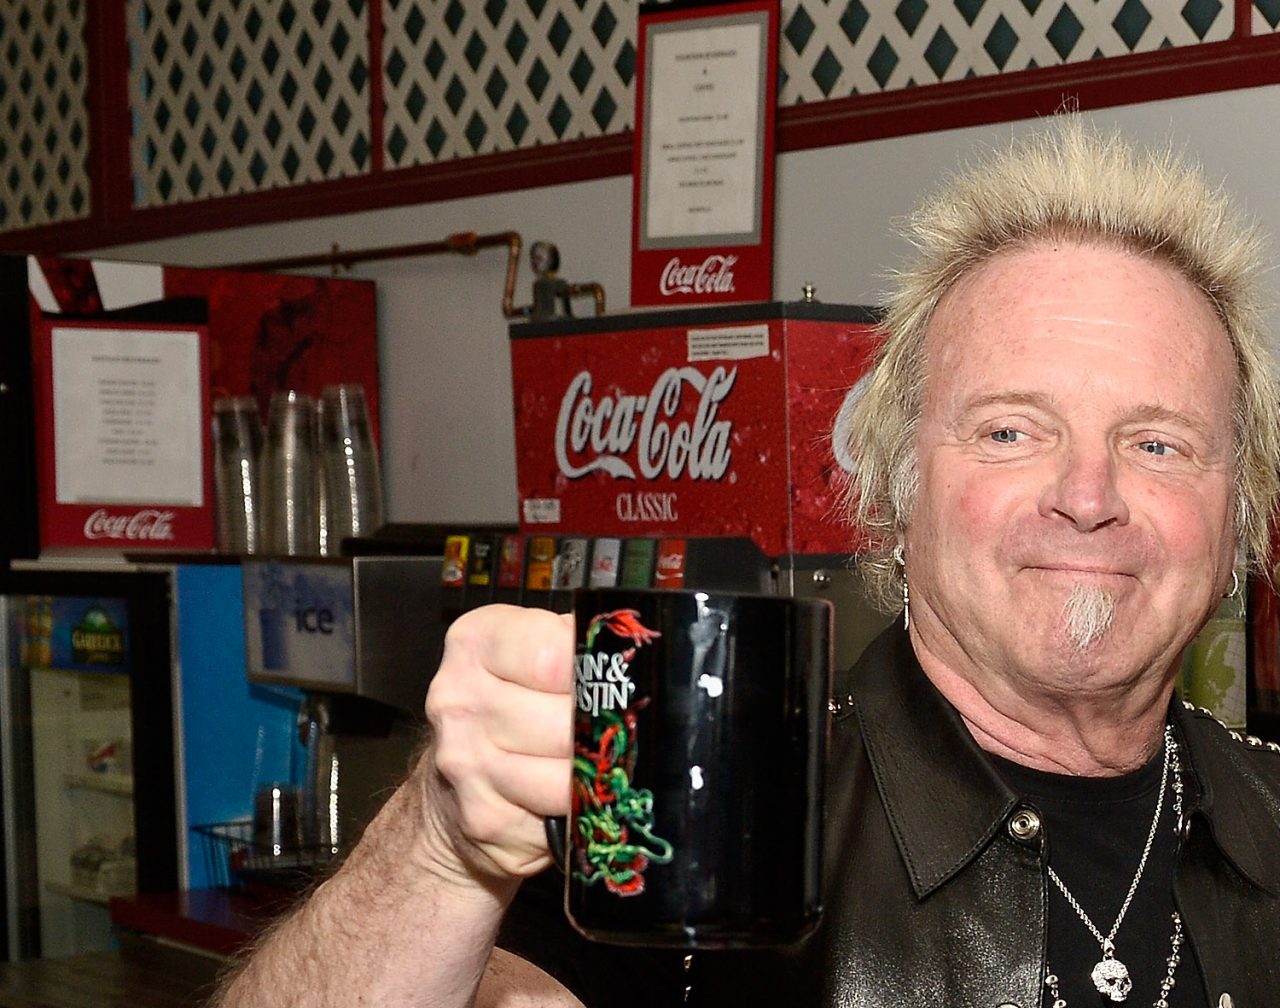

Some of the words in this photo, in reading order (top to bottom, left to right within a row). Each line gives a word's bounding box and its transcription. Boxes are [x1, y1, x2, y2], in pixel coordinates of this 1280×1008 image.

[555, 366, 737, 481] Coca-Cola
[616, 493, 678, 522] CLASSIC
[606, 652, 632, 683] &
